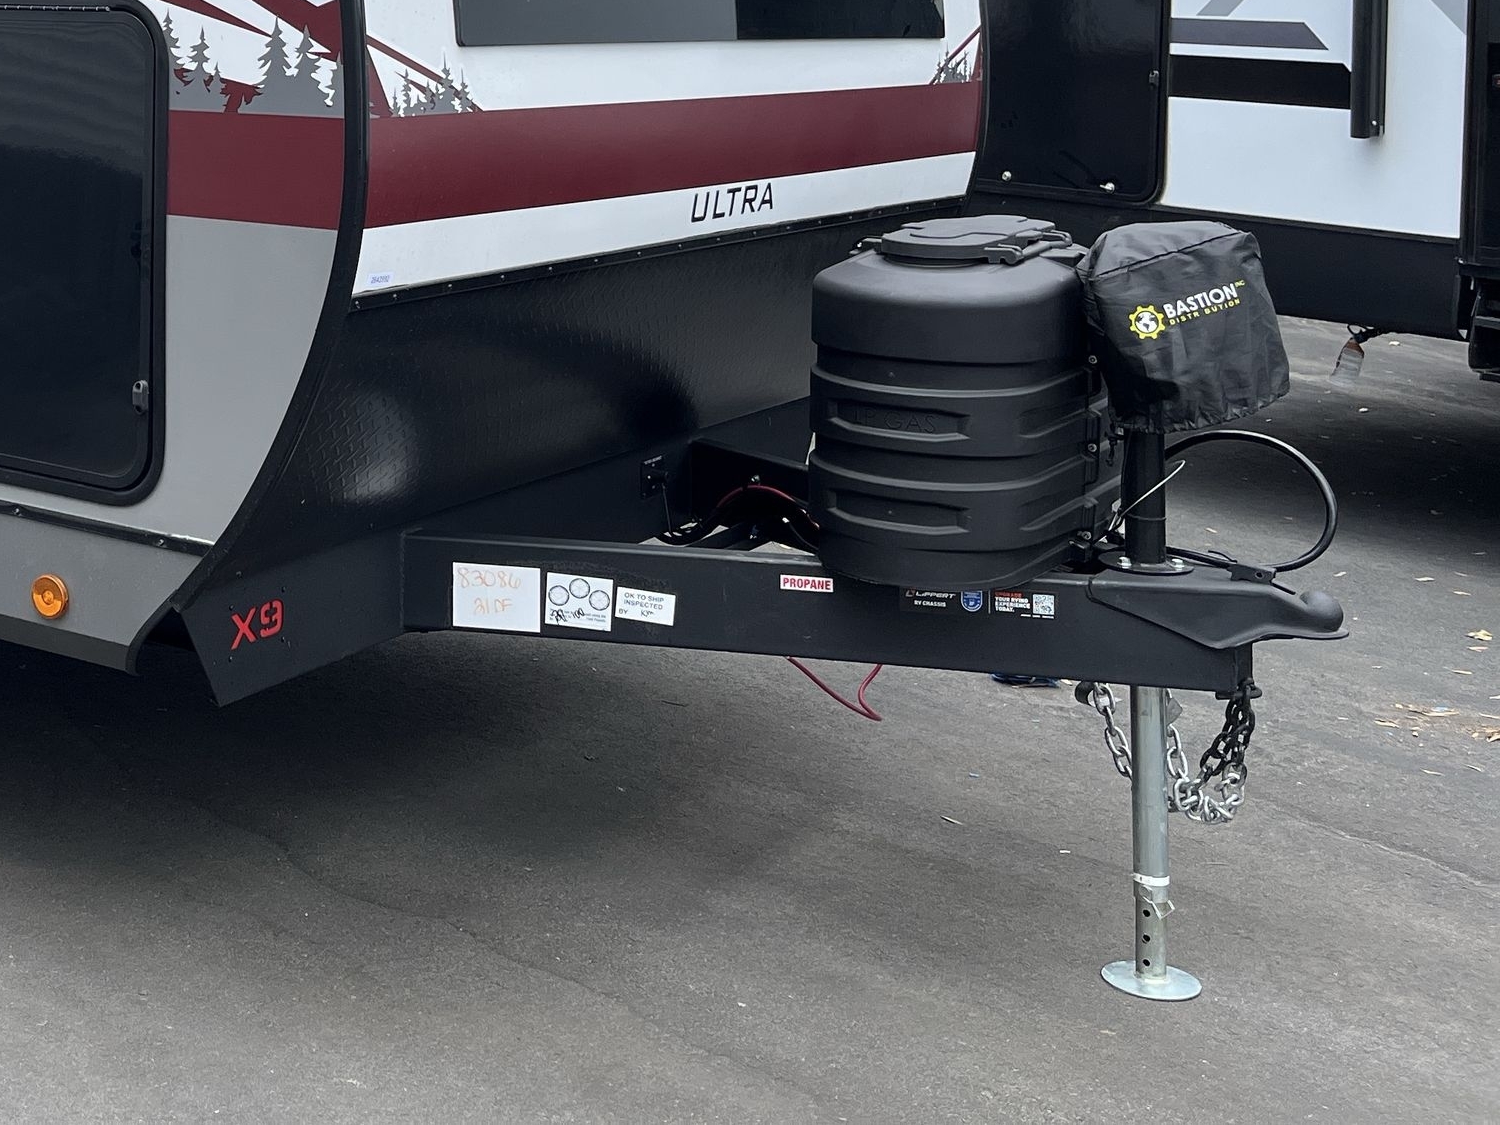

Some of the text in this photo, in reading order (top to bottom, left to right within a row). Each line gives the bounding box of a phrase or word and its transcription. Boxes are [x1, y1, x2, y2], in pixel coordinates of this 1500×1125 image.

[691, 182, 773, 223] ULTRA
[1163, 283, 1238, 319] BASTION
[883, 411, 938, 434] GAS
[783, 577, 831, 590] PROPANE
[623, 599, 664, 610] INSPECTED
[637, 593, 647, 601] TO
[647, 595, 665, 603] SHIP
[231, 599, 284, 651] X9
